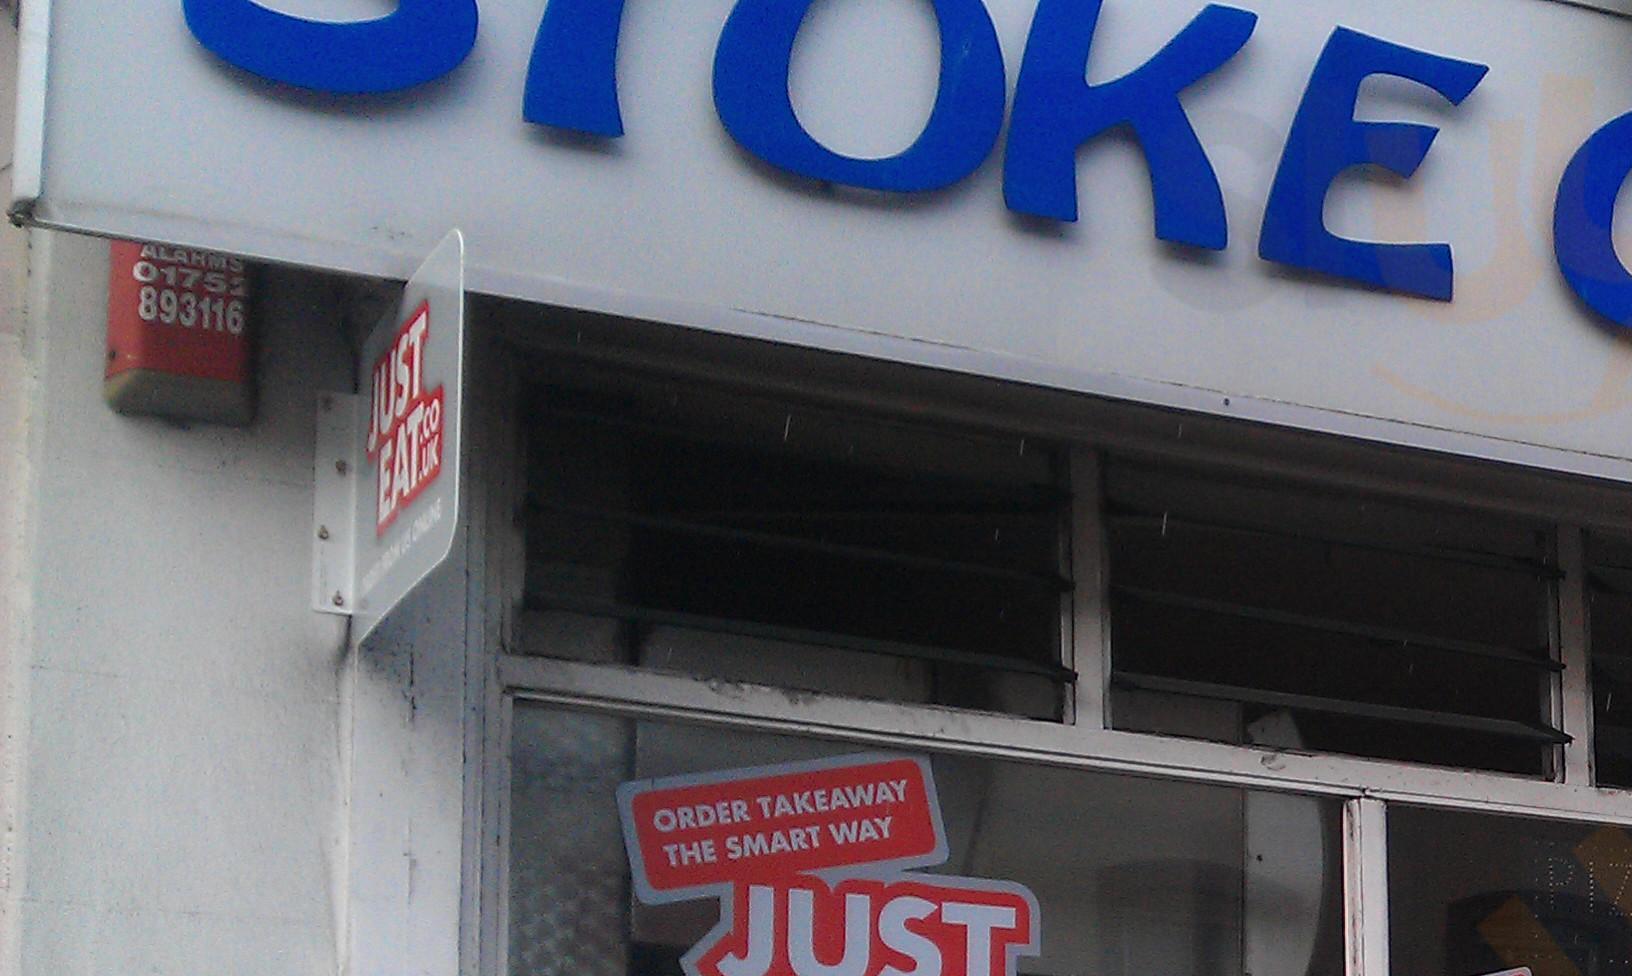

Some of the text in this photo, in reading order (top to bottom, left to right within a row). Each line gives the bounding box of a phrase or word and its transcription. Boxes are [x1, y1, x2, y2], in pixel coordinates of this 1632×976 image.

[138, 286, 244, 335] 893116
[369, 310, 427, 453] JUST
[378, 402, 424, 525] EAT
[654, 779, 908, 833] ORDER TAKEAWAY
[662, 816, 893, 868] THE SMART WAY
